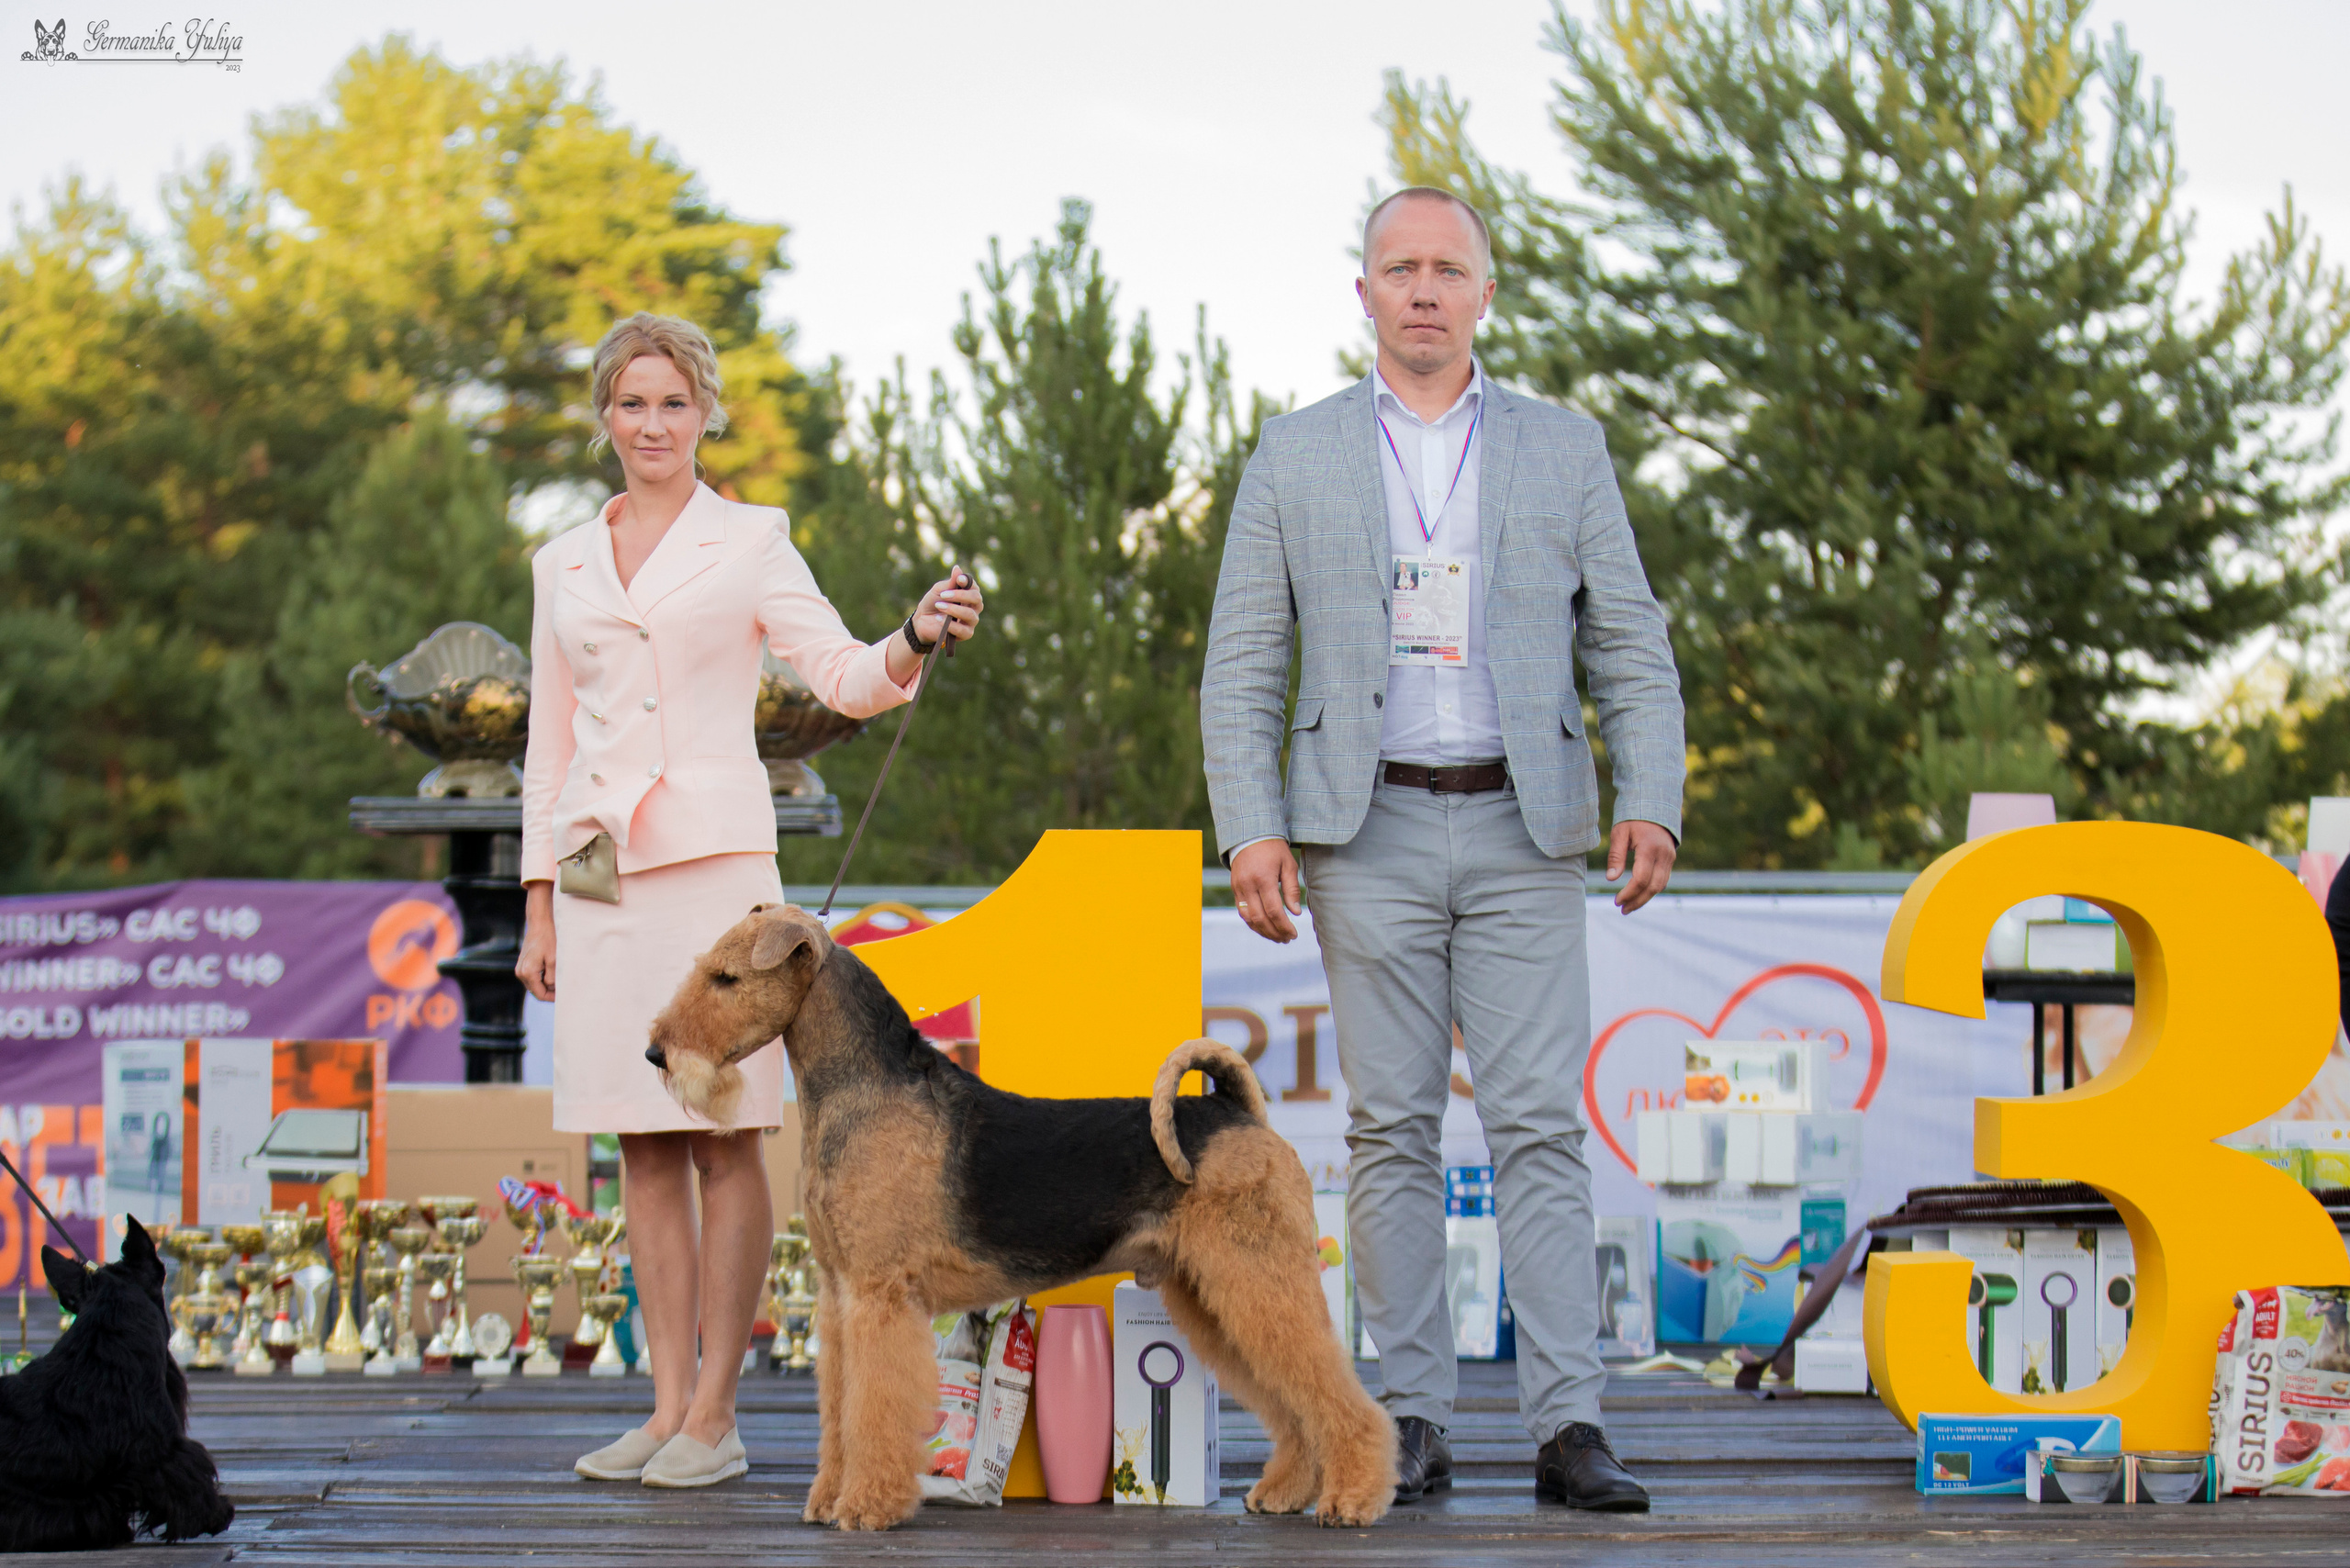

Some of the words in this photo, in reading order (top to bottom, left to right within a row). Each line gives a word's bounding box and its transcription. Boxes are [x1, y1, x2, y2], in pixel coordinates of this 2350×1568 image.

[0, 910, 120, 946] IRIUS»
[0, 1005, 84, 1040] OLD
[367, 991, 458, 1031] РКФ
[1863, 820, 2350, 1454] 3
[2255, 1311, 2276, 1322] ADULT
[2284, 1348, 2305, 1359] 40%
[2237, 1351, 2274, 1473] SIRIUS
